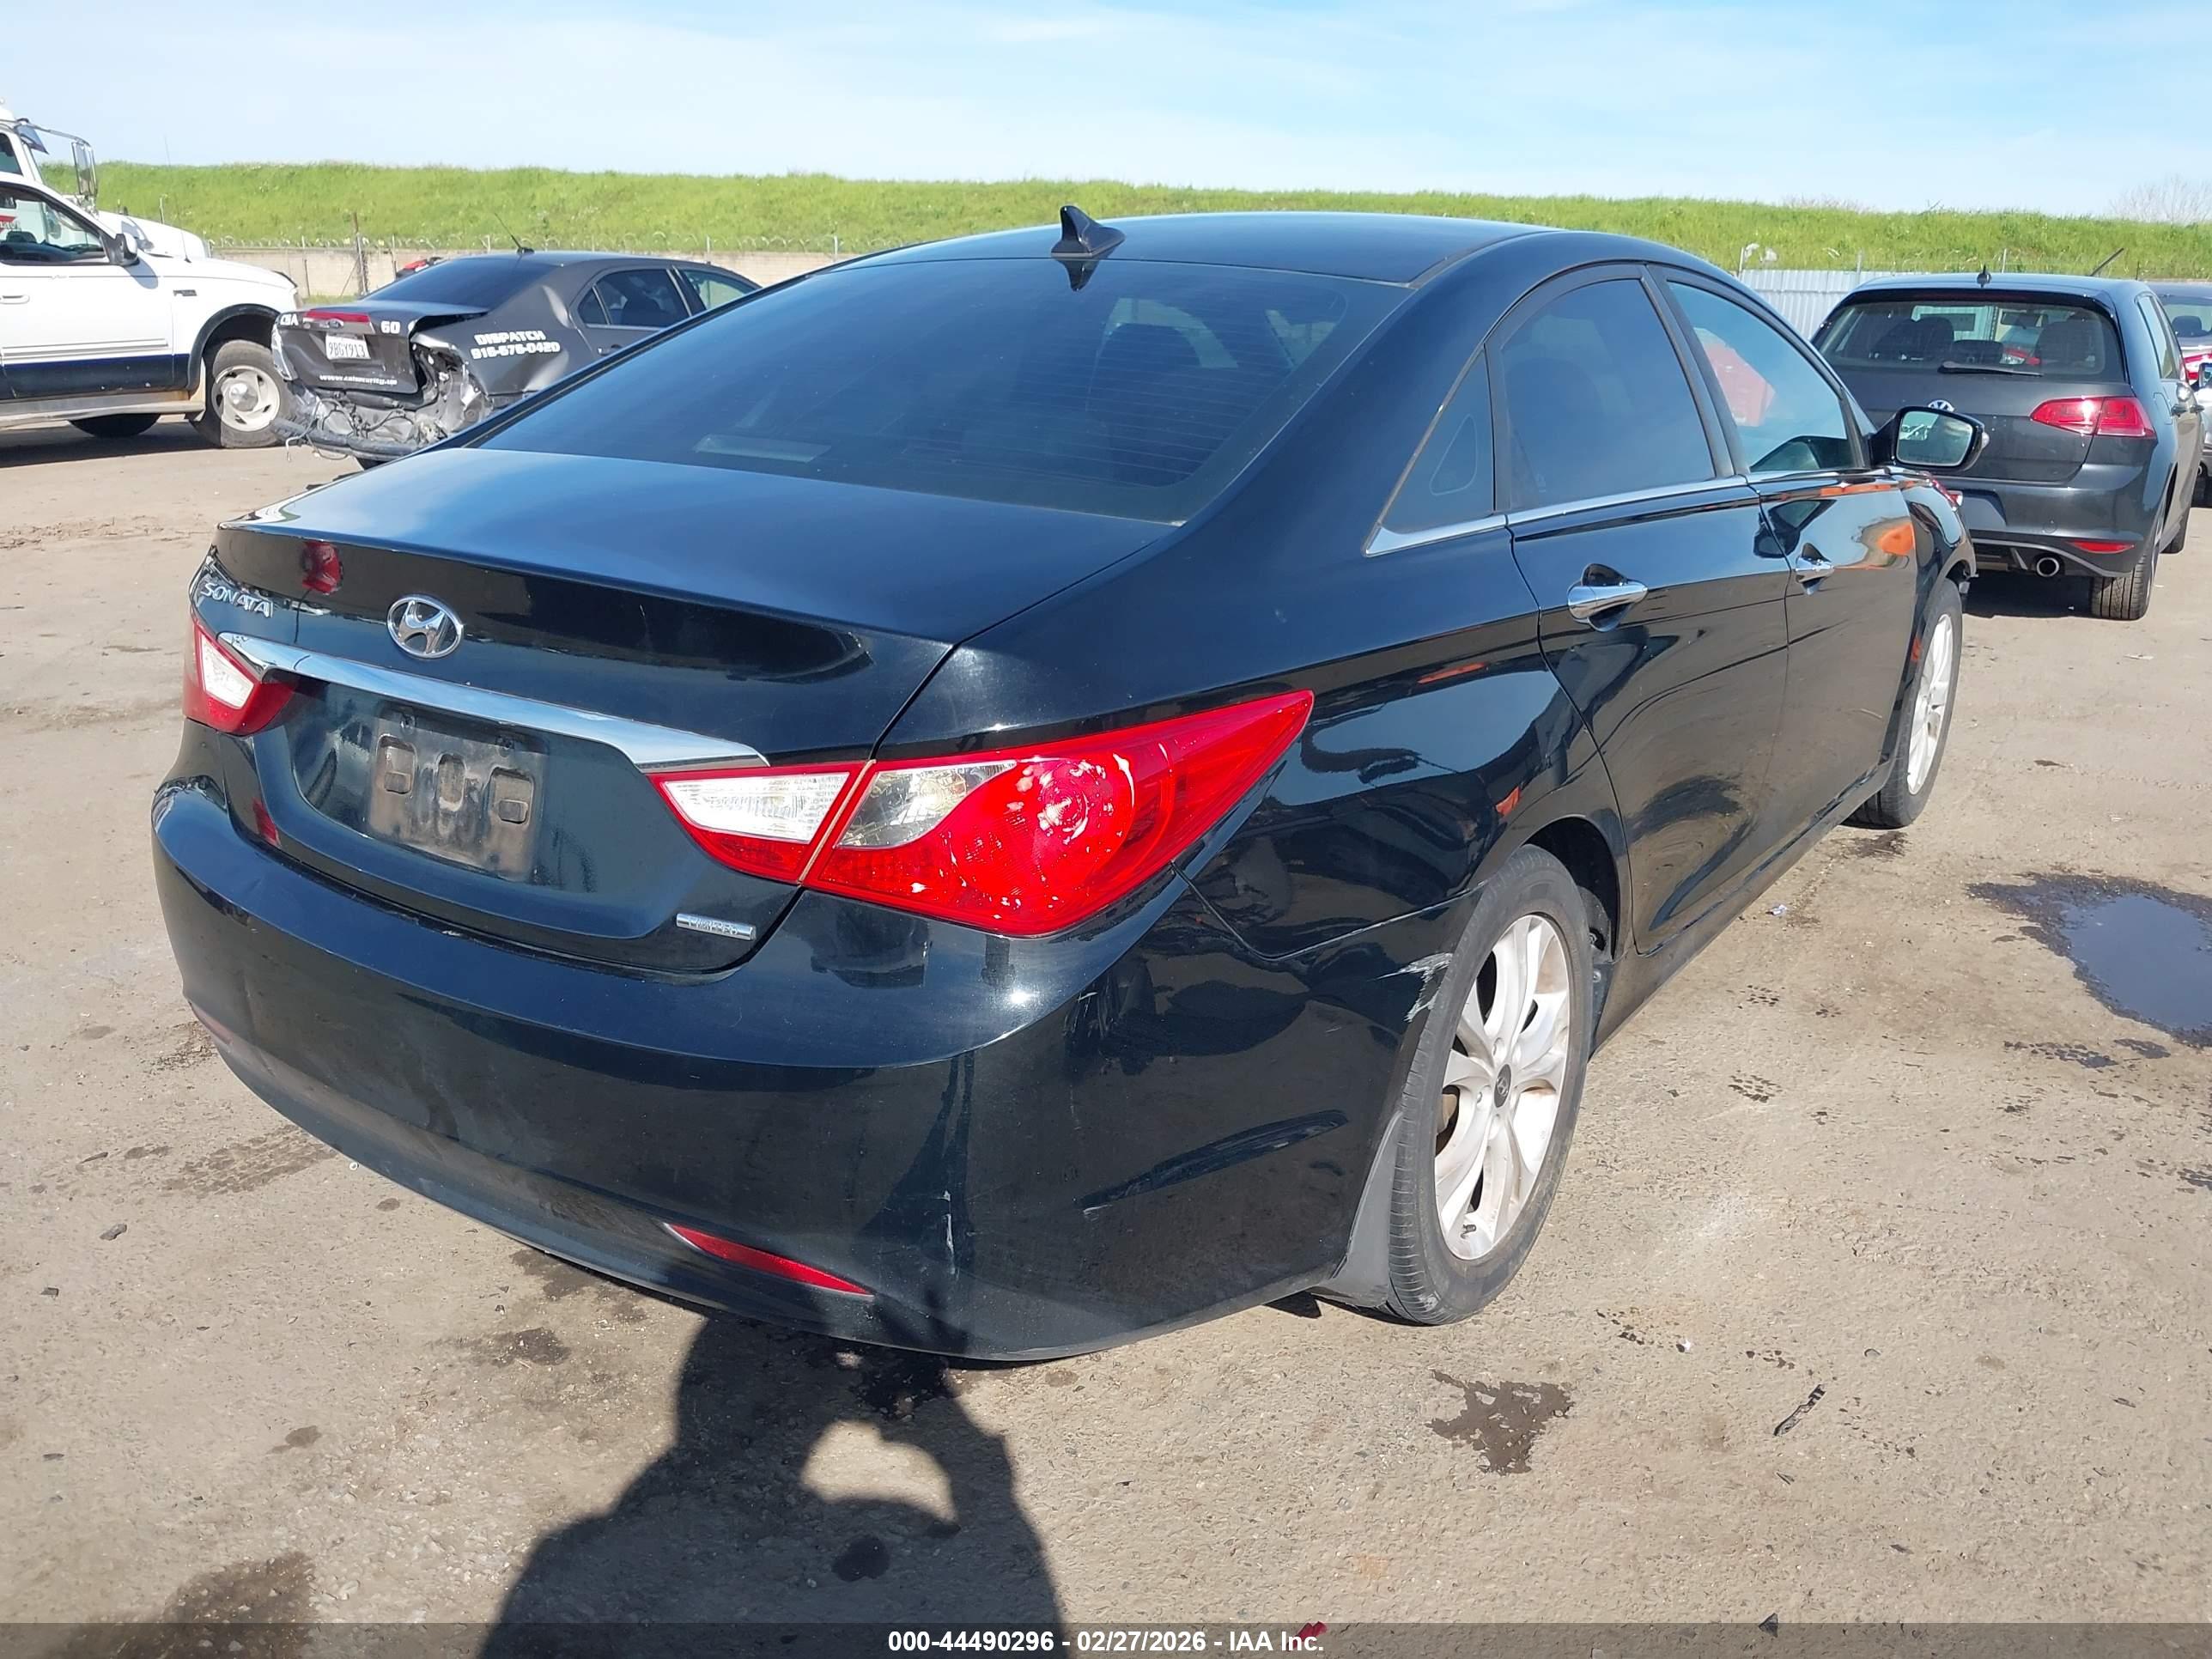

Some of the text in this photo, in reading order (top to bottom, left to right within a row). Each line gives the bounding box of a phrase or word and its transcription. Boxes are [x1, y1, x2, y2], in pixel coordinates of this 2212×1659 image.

[380, 320, 401, 334] 60
[474, 330, 546, 345] DISPATCH
[200, 582, 274, 618] SONATA
